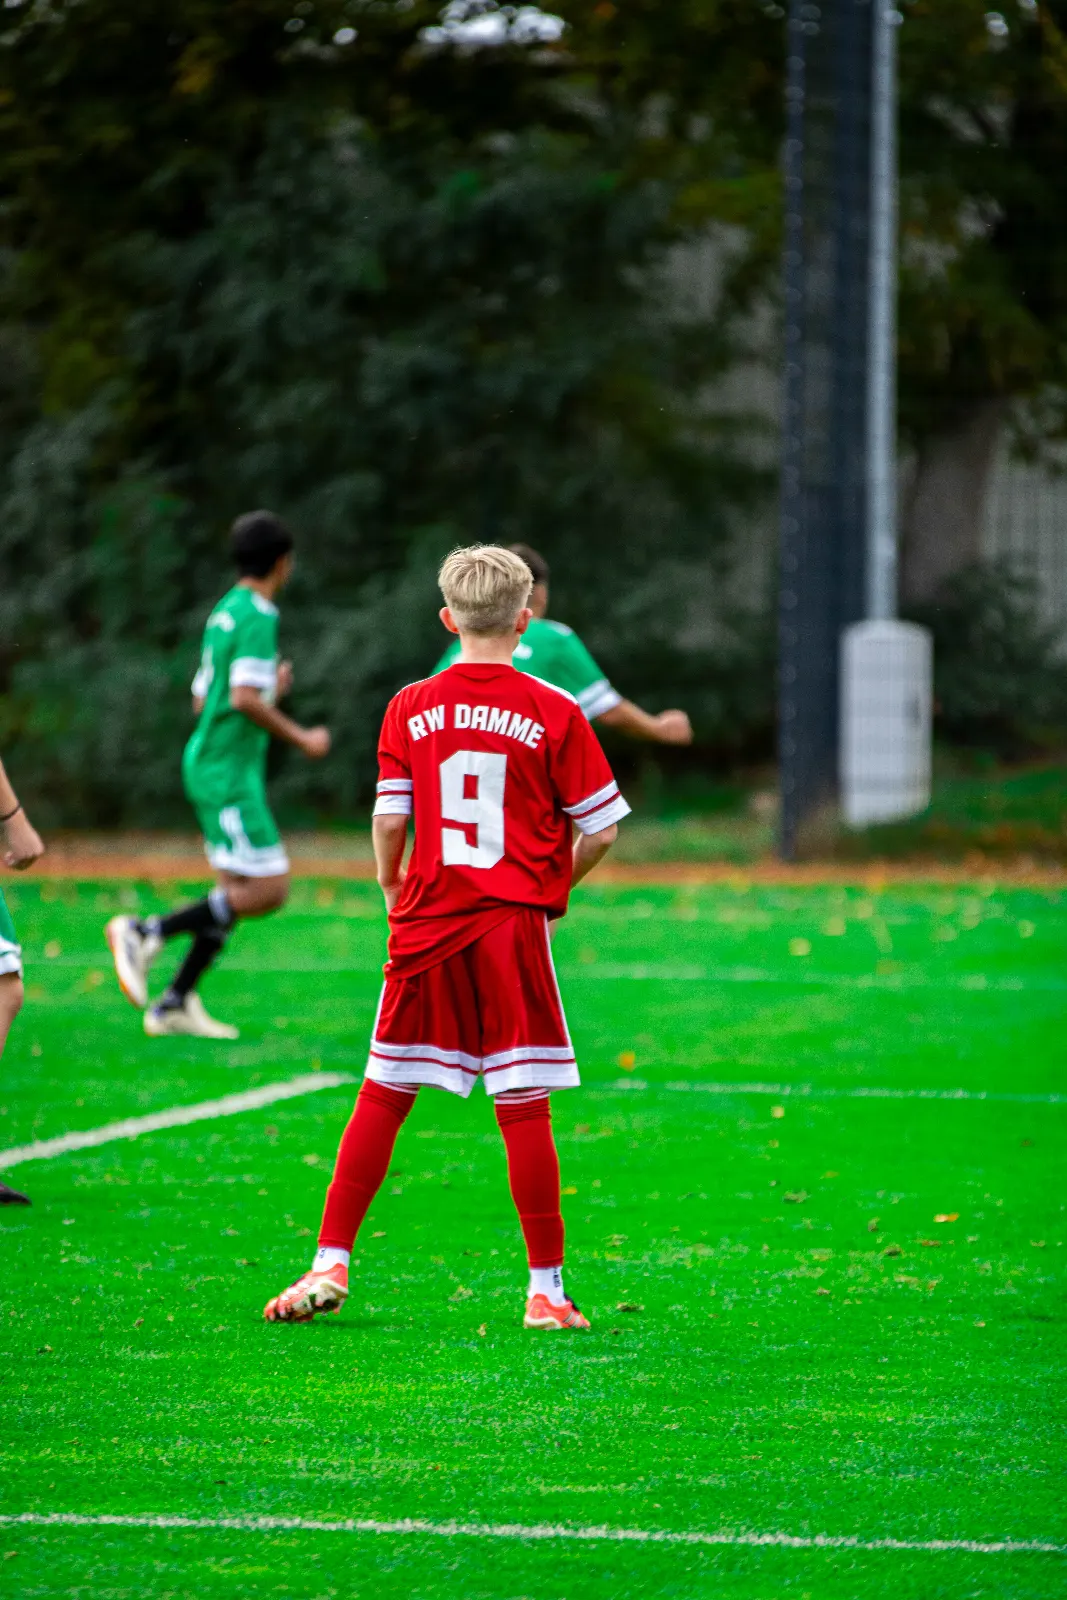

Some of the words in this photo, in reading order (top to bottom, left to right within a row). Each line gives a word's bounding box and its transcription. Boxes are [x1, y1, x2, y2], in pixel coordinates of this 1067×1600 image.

[408, 705, 445, 741] RW
[454, 704, 545, 748] DAMME
[440, 750, 507, 869] 9
